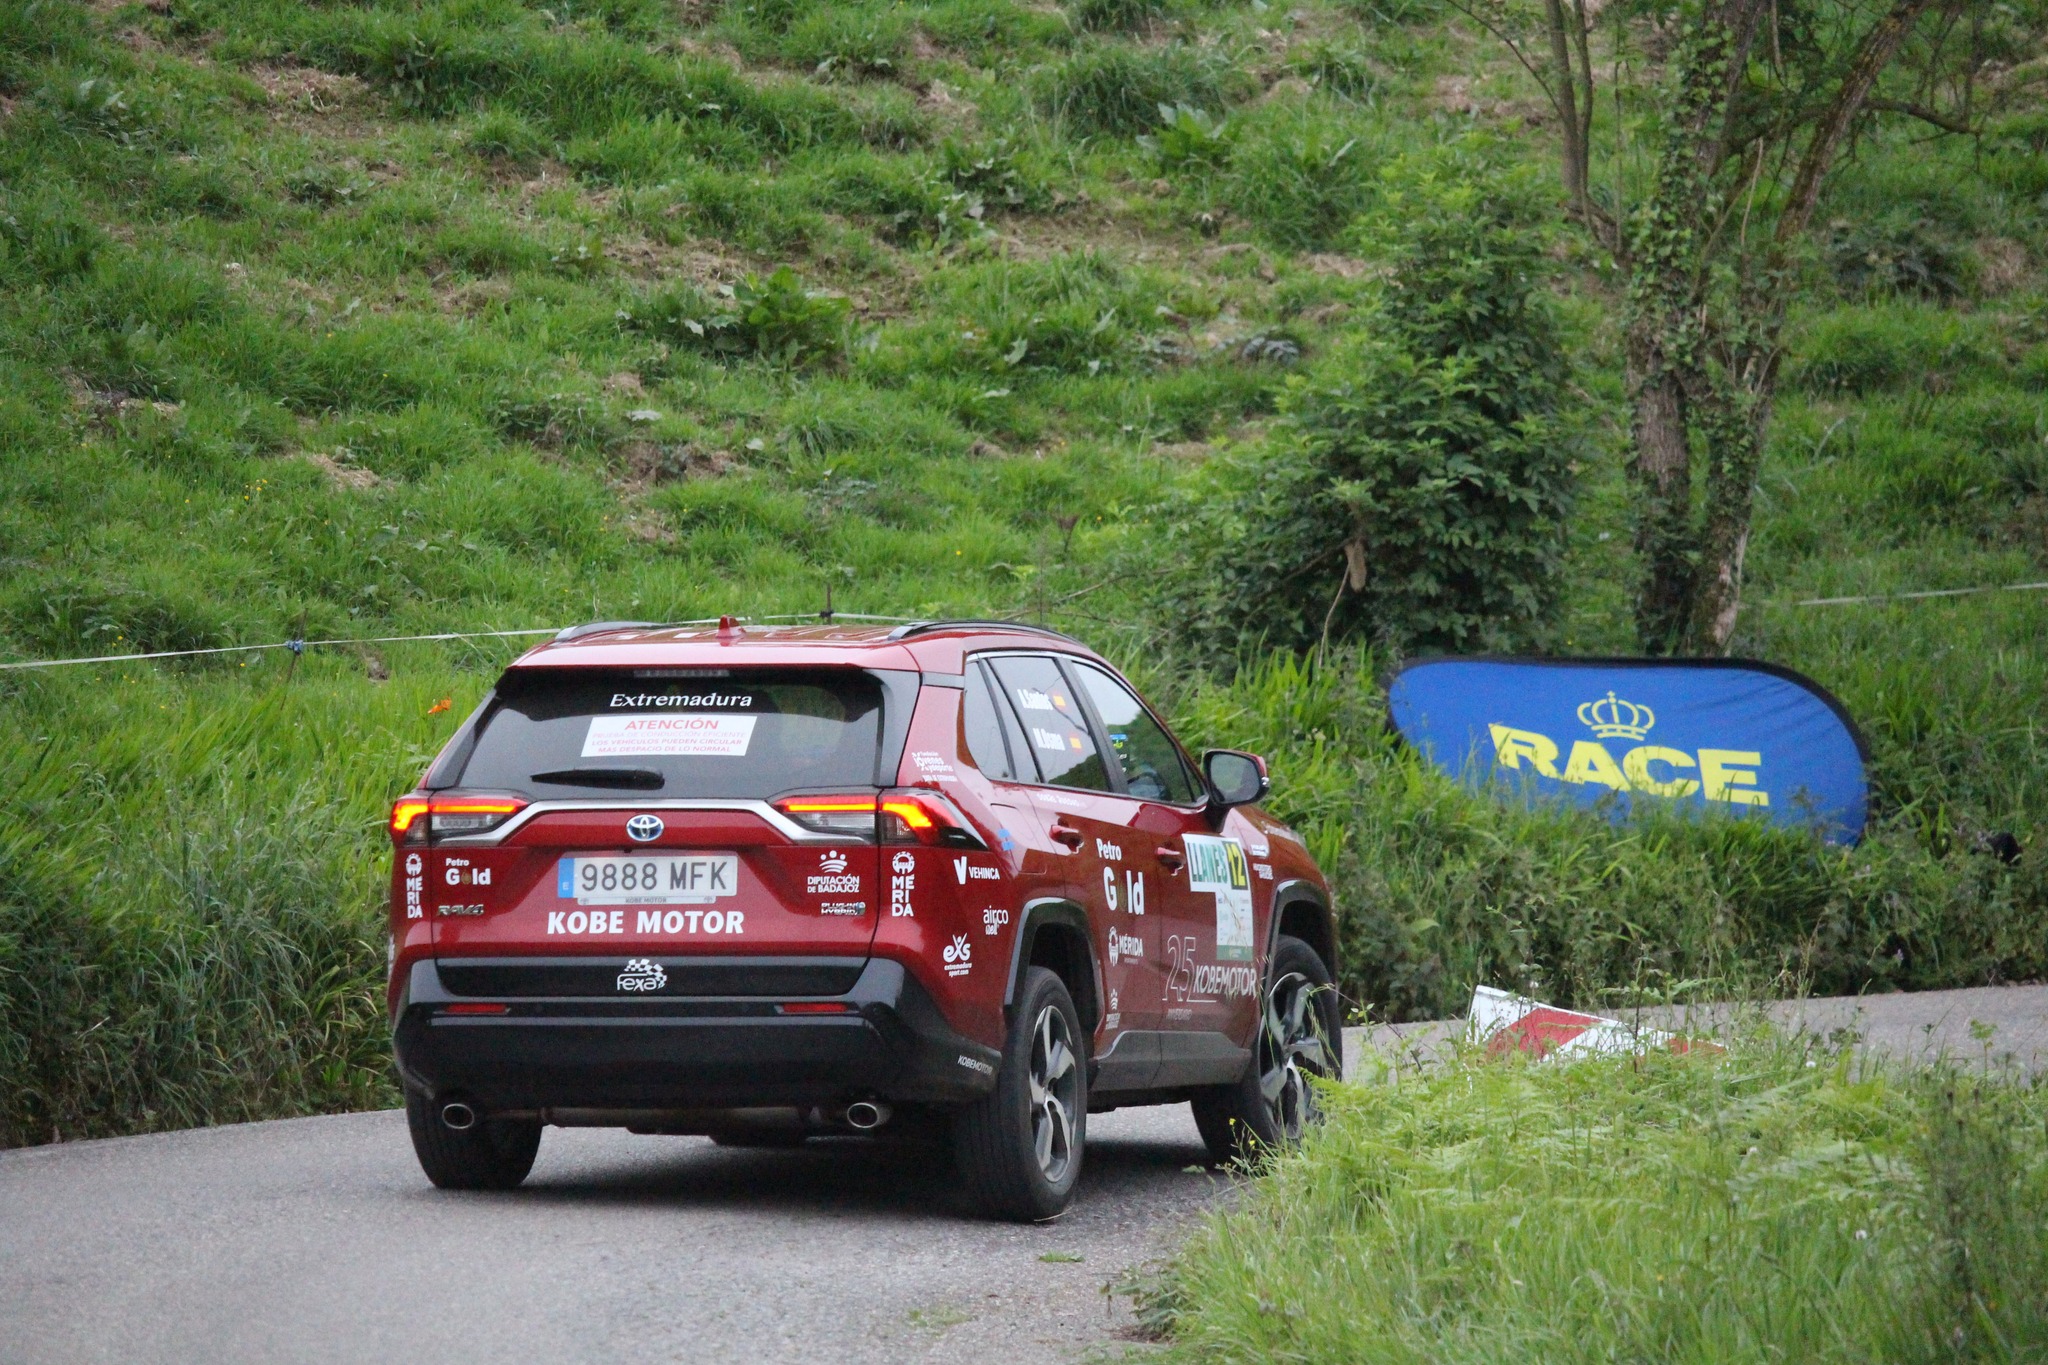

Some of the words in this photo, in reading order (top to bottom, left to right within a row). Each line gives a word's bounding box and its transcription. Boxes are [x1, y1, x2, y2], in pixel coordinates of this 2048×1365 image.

[609, 692, 753, 707] Extremadura
[625, 718, 719, 730] ATENCIÓN
[641, 730, 700, 738] CONDUCCIÓN
[1488, 723, 1769, 806] RACE
[1096, 837, 1122, 861] Petro
[445, 857, 470, 867] Petro
[1187, 842, 1228, 884] LLANES
[1225, 843, 1246, 887] 12
[582, 863, 658, 892] 9888
[669, 861, 728, 890] MFK
[807, 873, 860, 885] DIPUTACIÓN
[968, 866, 1000, 880] VEHINCA
[807, 885, 816, 893] DE
[817, 884, 860, 893] BADAJOZ
[437, 904, 485, 916] RAV4
[983, 905, 1009, 925] airco
[547, 911, 624, 935] KOBE
[636, 911, 745, 935] MOTOR
[1119, 934, 1144, 957] MÉRIDA
[1193, 965, 1257, 1000] KOBEMOTOR
[957, 1054, 993, 1076] KOBEMOTOR
